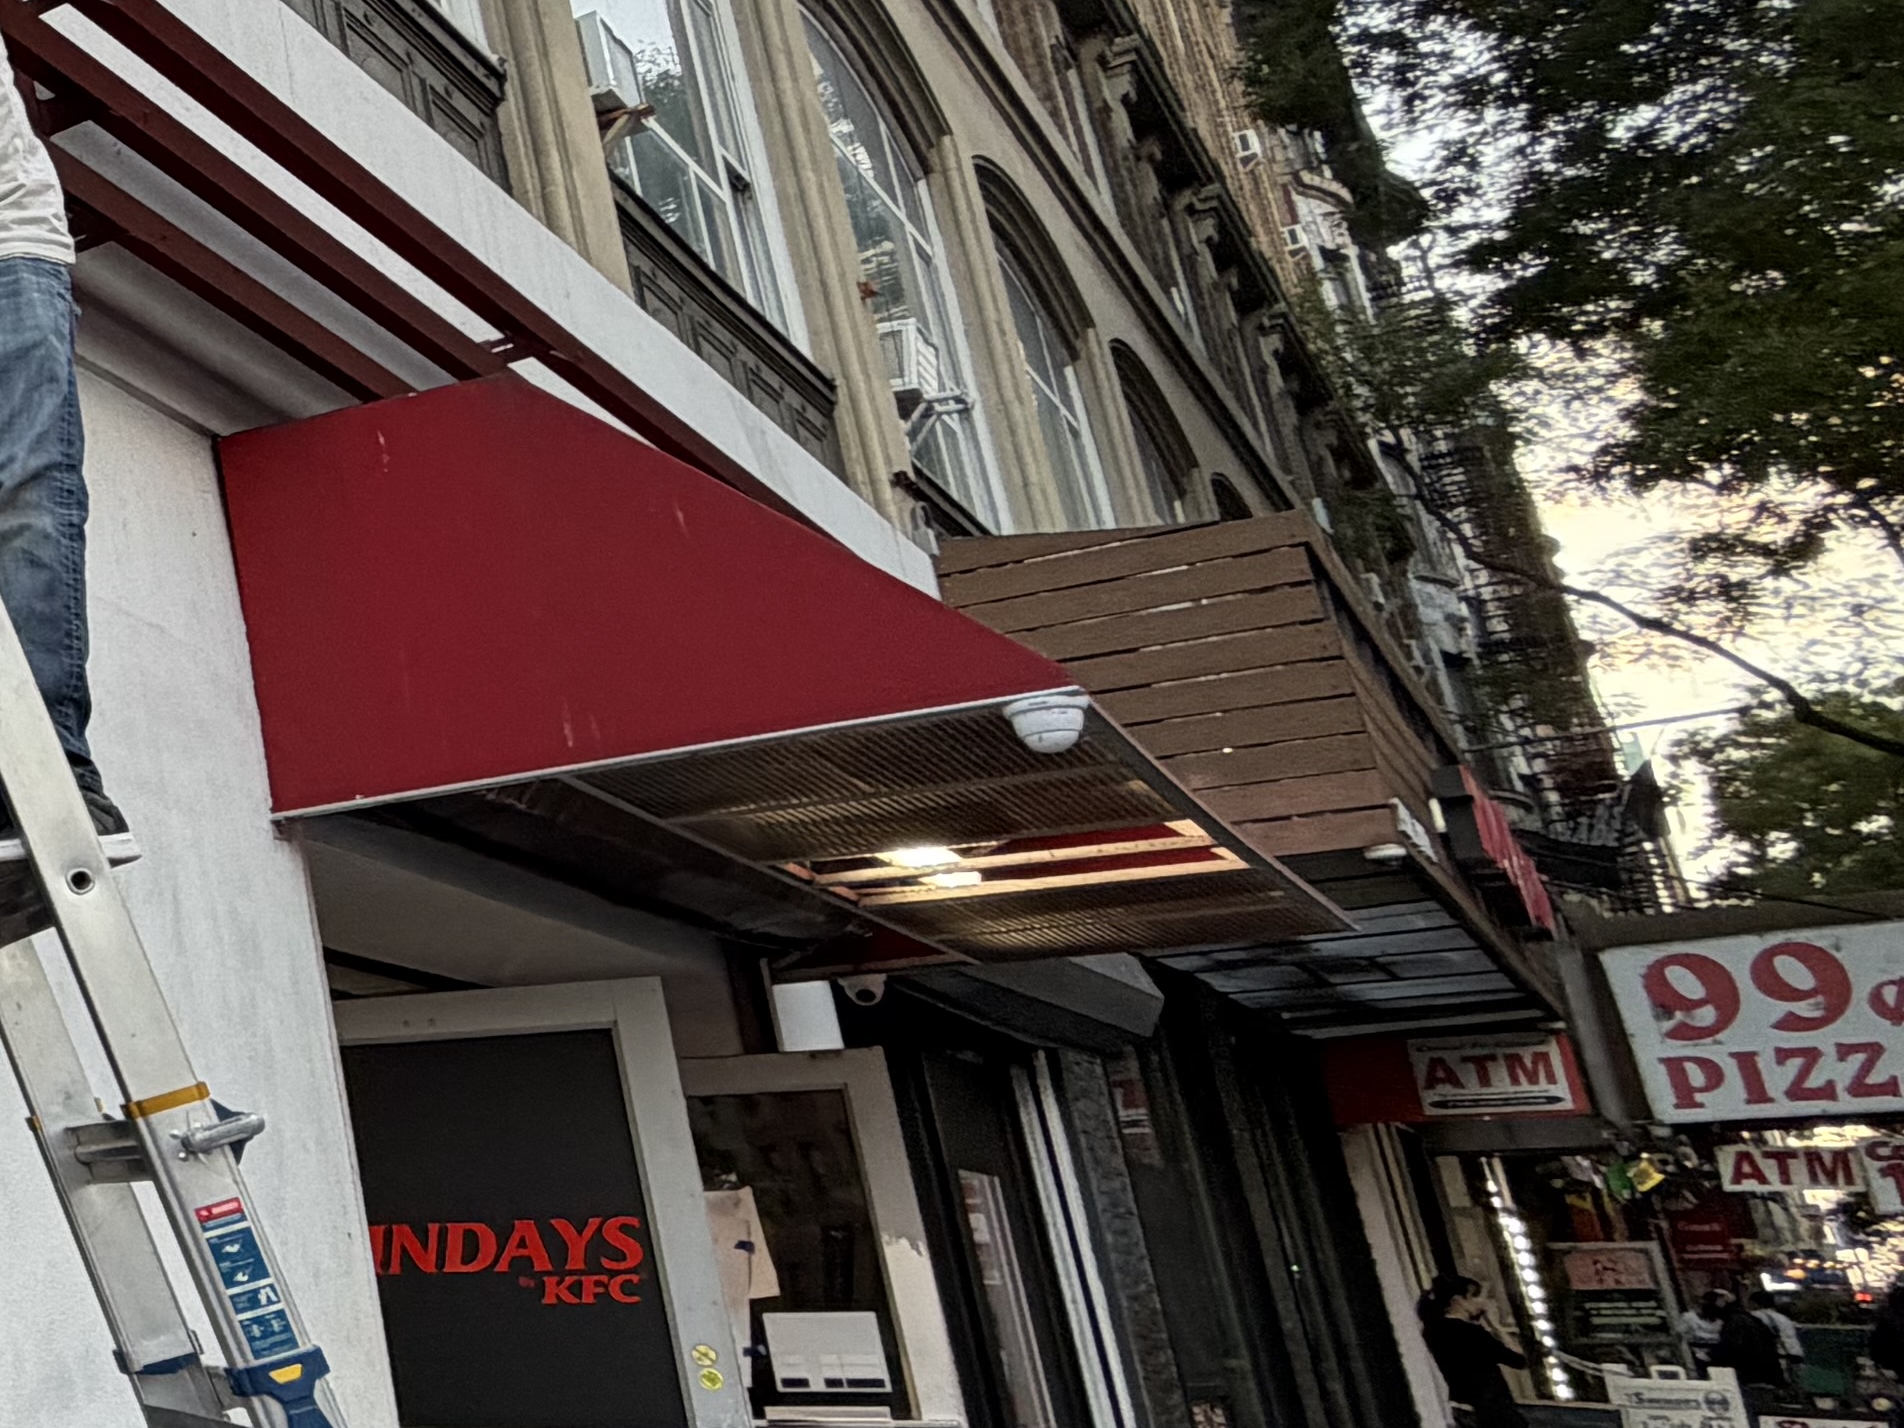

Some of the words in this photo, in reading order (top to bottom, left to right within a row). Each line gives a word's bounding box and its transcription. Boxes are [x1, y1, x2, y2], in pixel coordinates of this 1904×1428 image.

[1423, 1051, 1559, 1091] ATM
[1730, 1150, 1856, 1186] ATM
[541, 1274, 642, 1305] KFC
